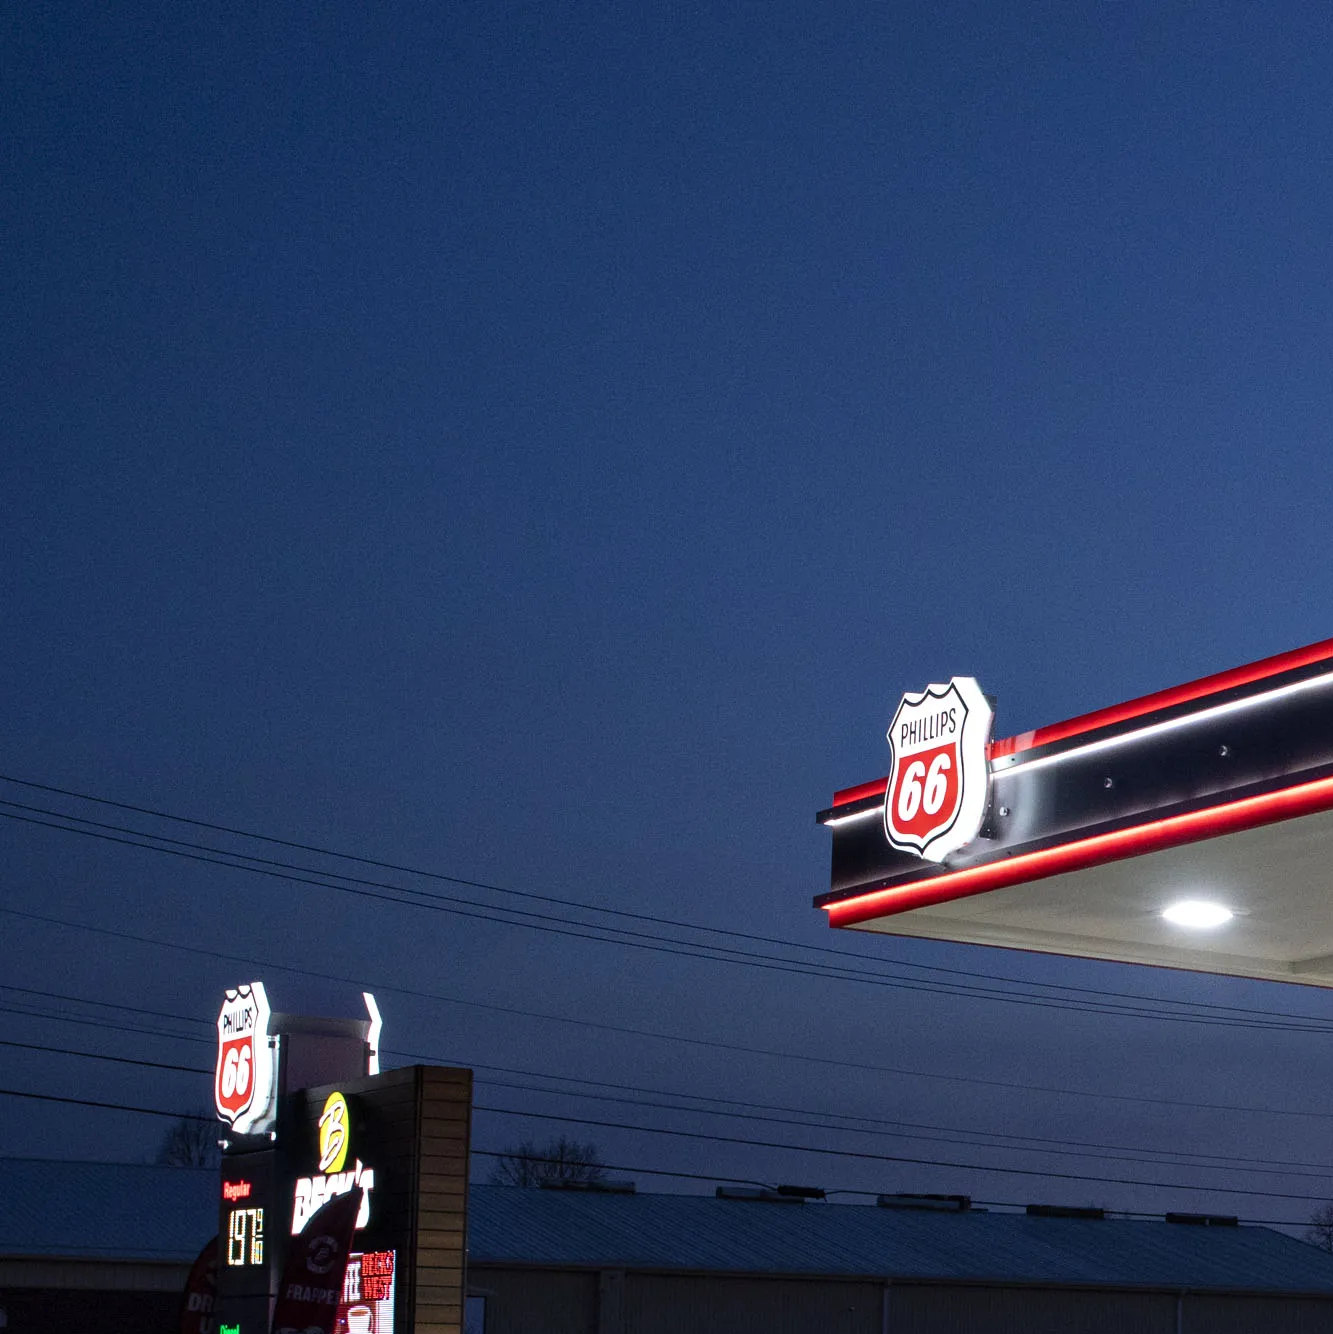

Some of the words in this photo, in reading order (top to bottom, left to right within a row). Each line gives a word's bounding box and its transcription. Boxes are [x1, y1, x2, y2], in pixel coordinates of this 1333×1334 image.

[901, 708, 957, 748] PHILLIPS
[898, 753, 951, 822] 66
[223, 1006, 253, 1034] PHILLIPS
[221, 1044, 251, 1099] 66
[223, 1180, 250, 1202] Regular
[363, 1276, 392, 1299] WEST
